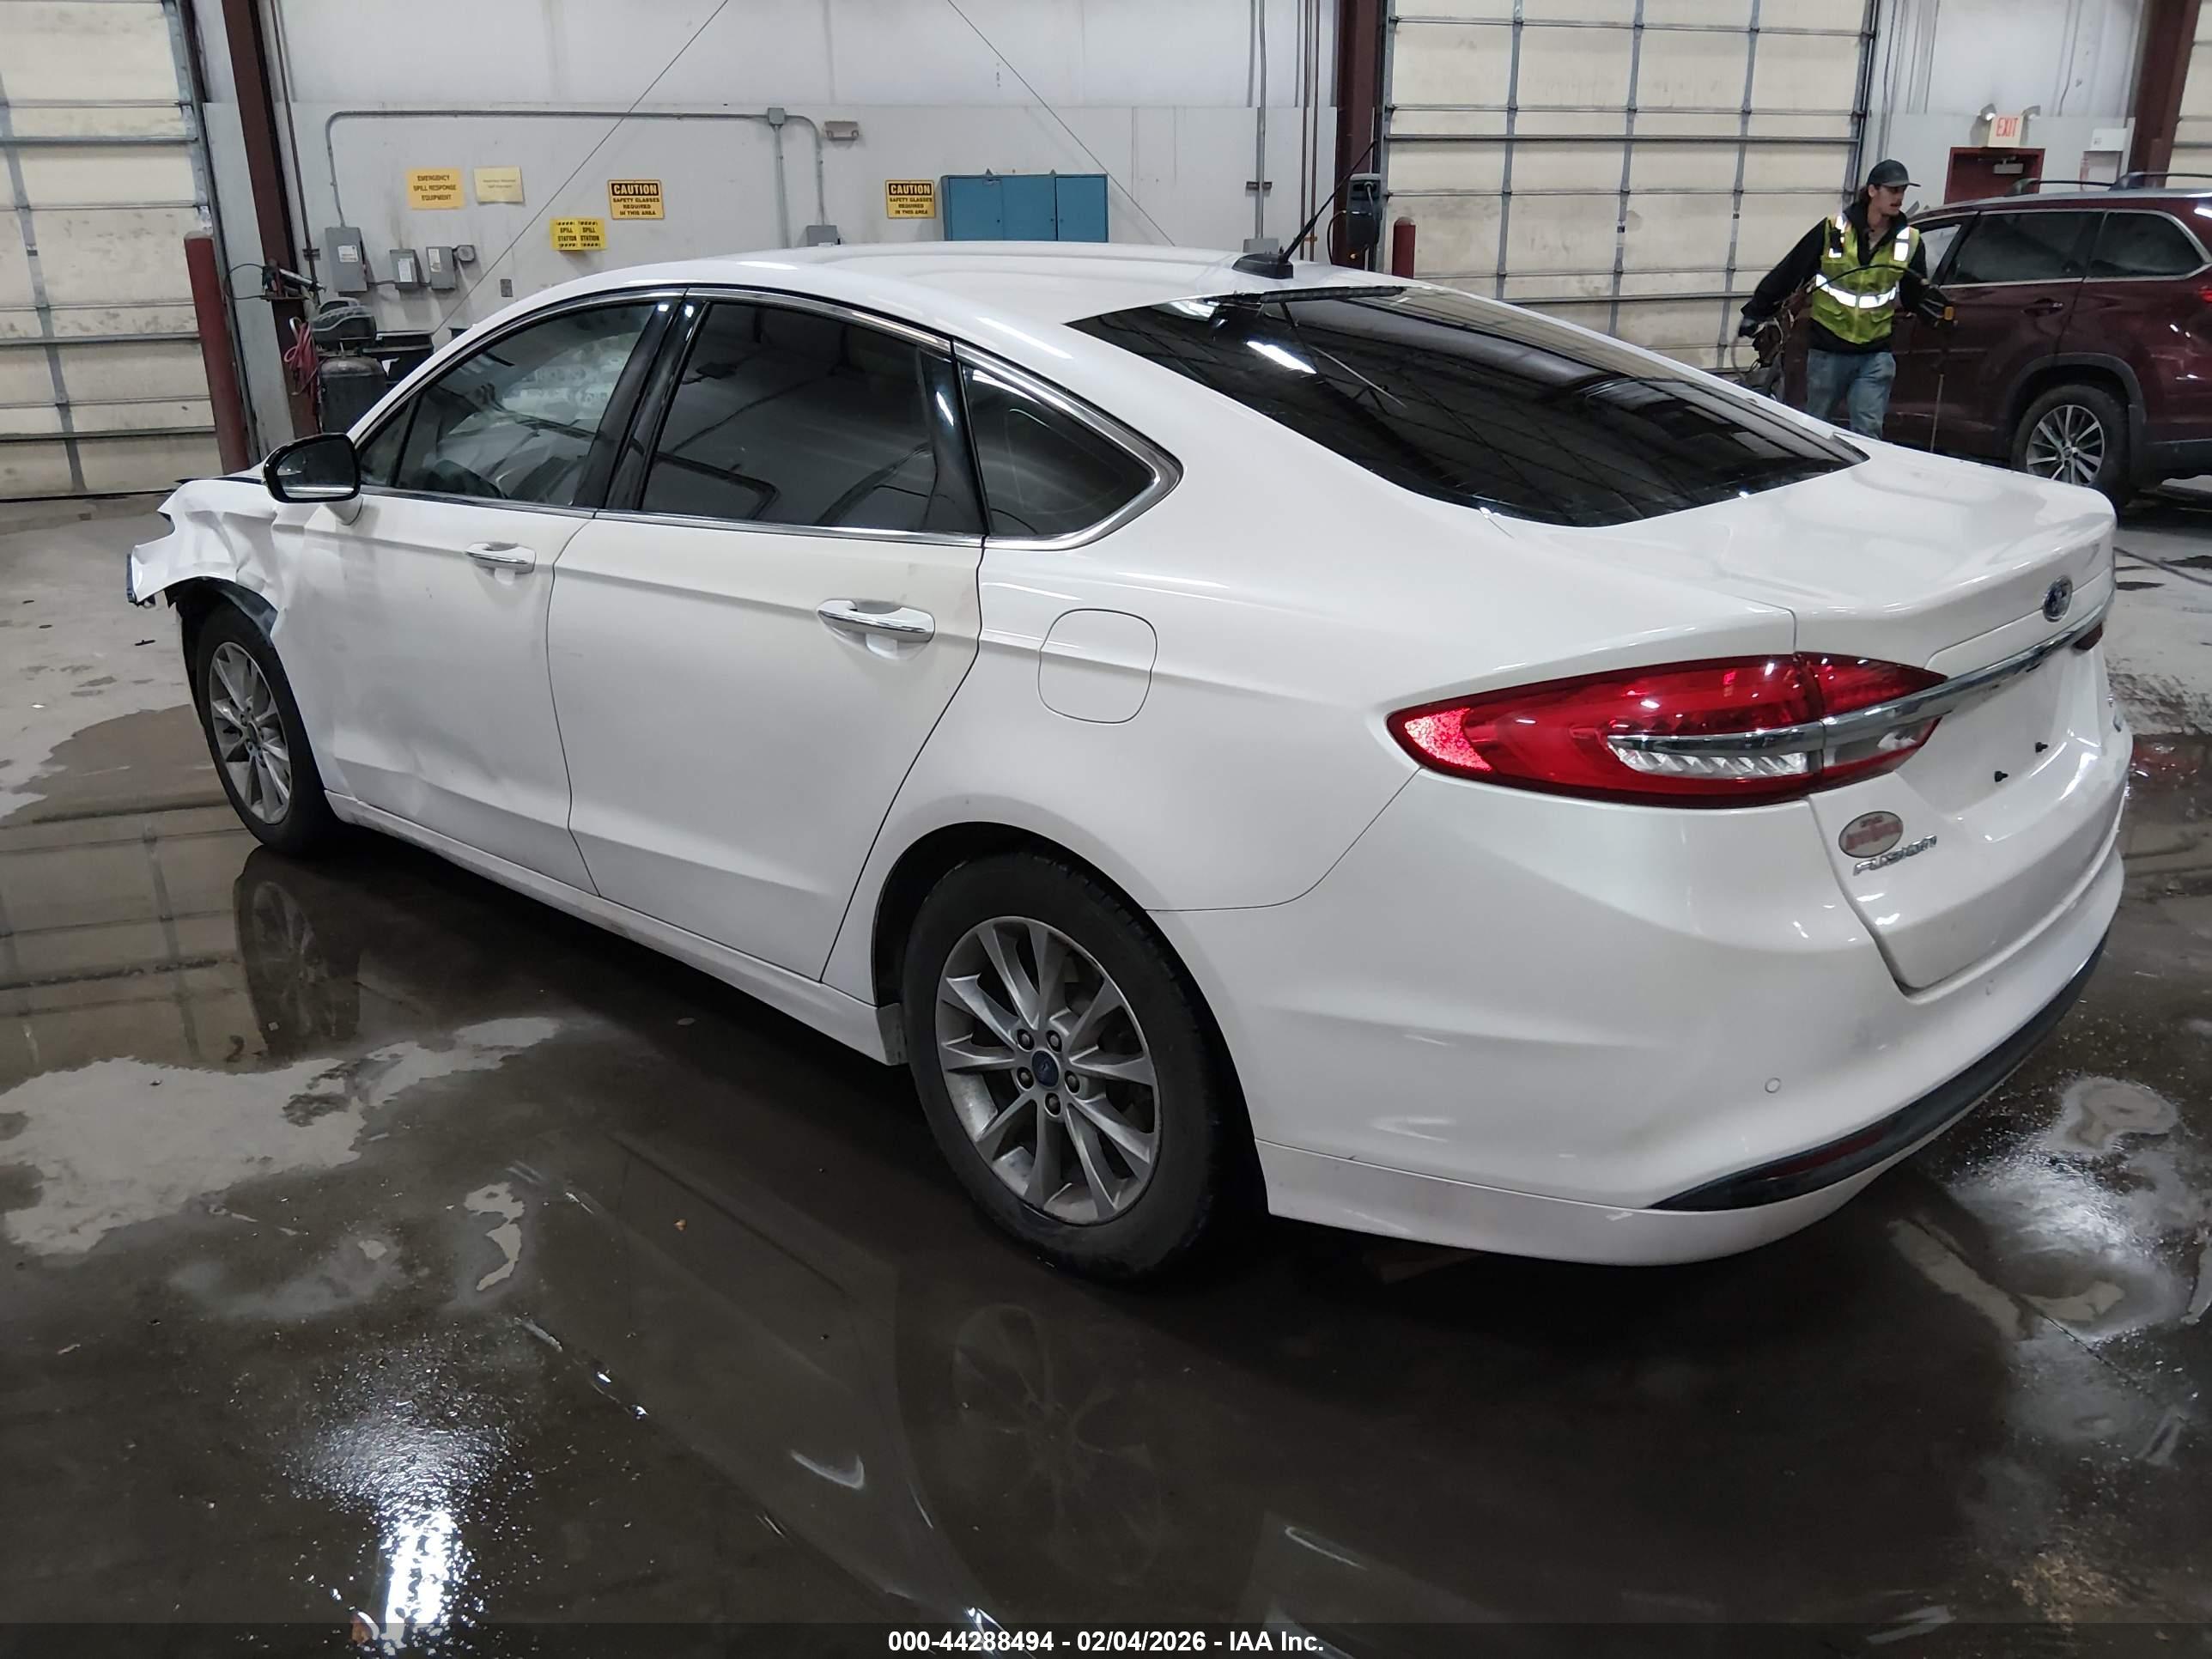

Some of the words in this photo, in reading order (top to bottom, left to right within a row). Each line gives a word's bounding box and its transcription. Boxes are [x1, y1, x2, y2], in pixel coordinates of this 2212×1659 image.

[1996, 117, 2019, 137] EXIT
[613, 185, 658, 195] CAUTION
[890, 184, 931, 195] CAUTION
